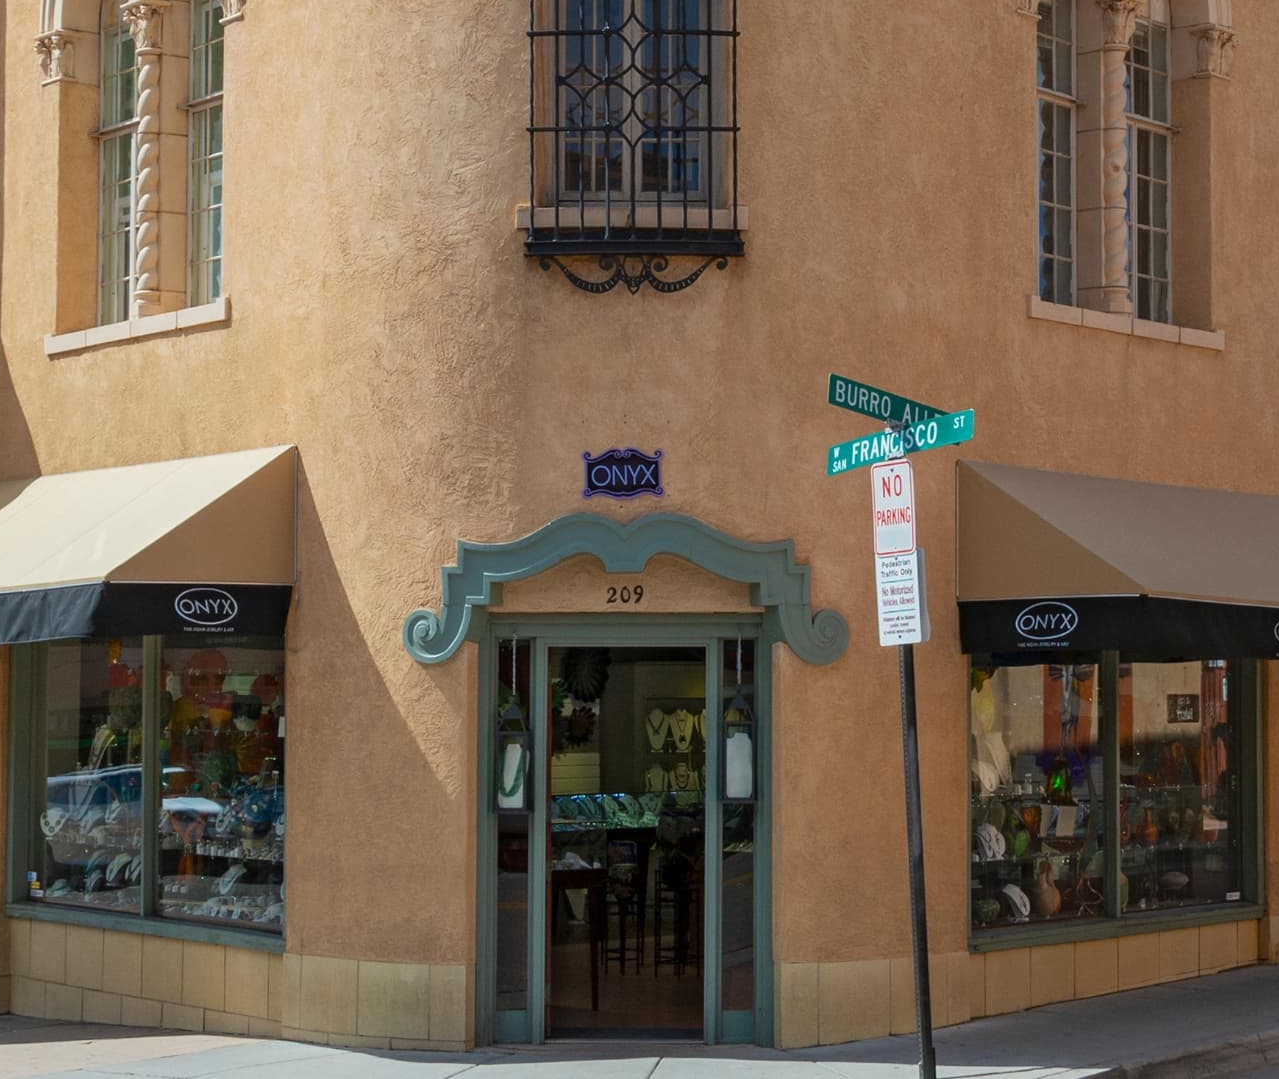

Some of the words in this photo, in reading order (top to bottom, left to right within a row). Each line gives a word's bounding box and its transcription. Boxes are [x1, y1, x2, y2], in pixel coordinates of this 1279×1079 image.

[835, 380, 891, 417] BURRO
[832, 458, 847, 473] SAN
[851, 422, 938, 465] FRANCISCO
[953, 415, 965, 429] ST
[833, 446, 841, 459] W
[591, 463, 656, 487] ONYX
[881, 474, 903, 498] NO
[876, 506, 912, 527] PARKING
[881, 558, 911, 570] Pedestrian
[900, 568, 913, 578] Only
[606, 584, 644, 604] 209
[179, 598, 233, 615] ONYX
[1019, 613, 1072, 631] ONYX
